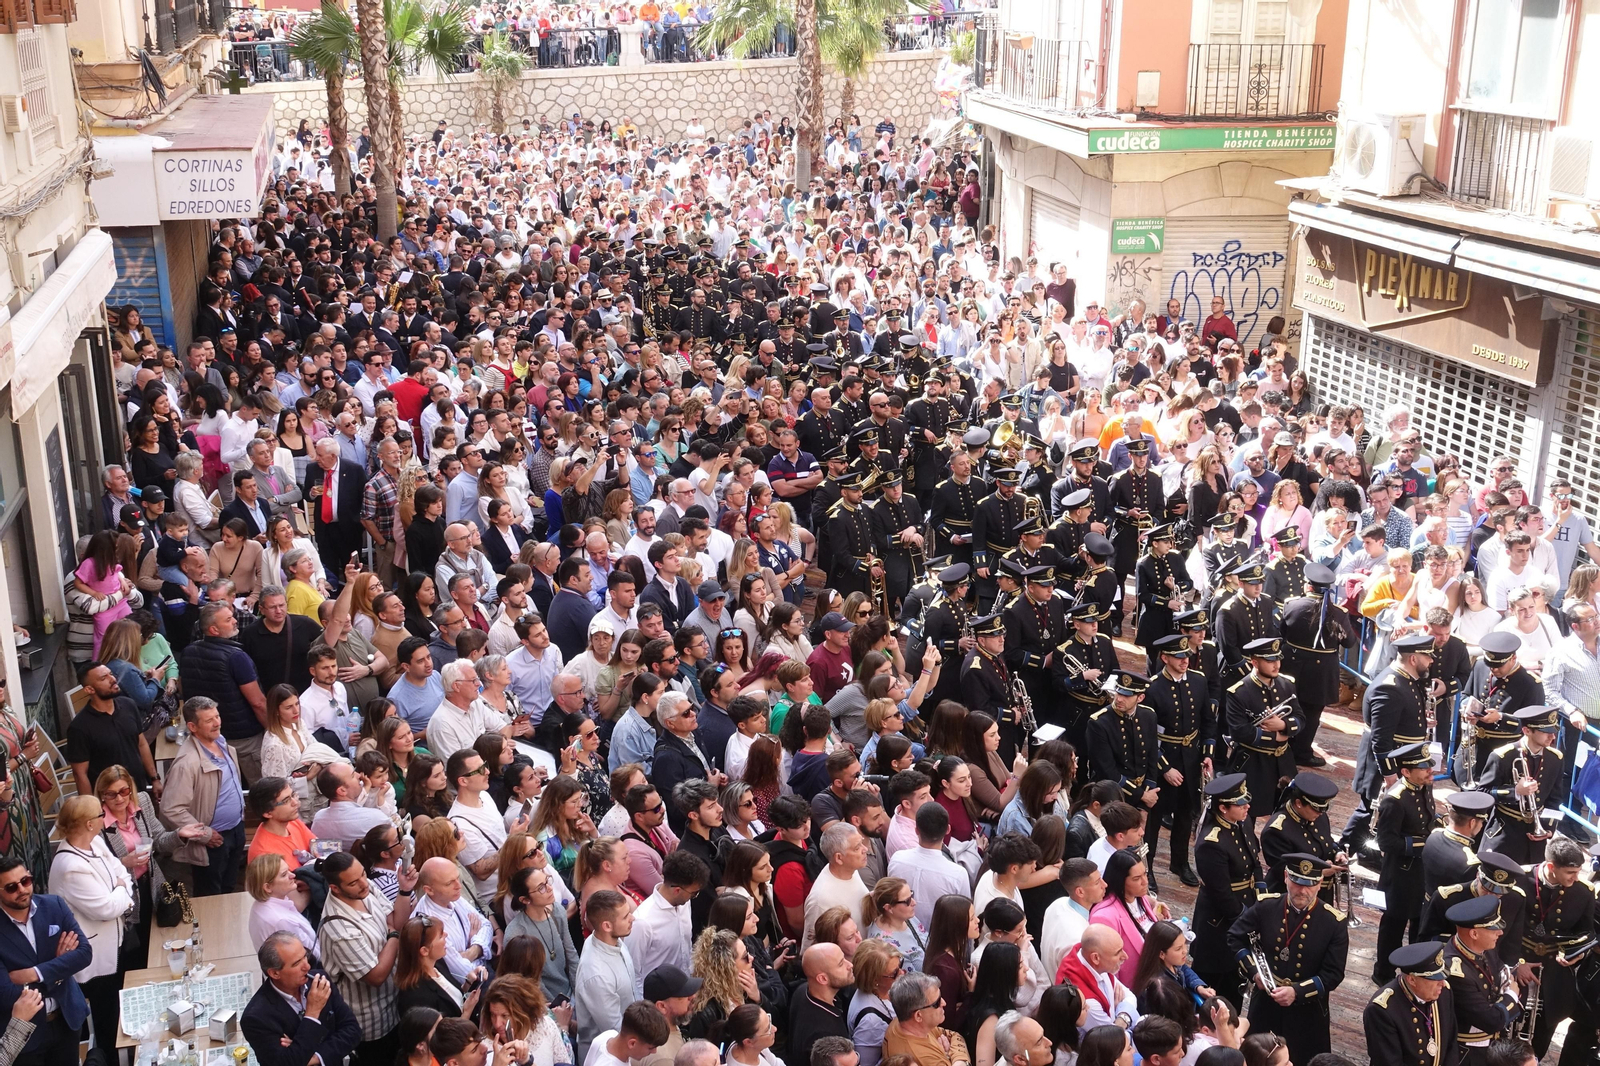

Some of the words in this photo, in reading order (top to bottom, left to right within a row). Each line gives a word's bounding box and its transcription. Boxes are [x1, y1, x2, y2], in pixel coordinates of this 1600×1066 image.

[1224, 129, 1268, 139] TIENDA
[1276, 127, 1333, 137] BENÉFICA
[1096, 131, 1160, 151] cudeca
[1223, 139, 1262, 148] HOSPICE
[1266, 138, 1305, 147] CHARITY
[1308, 137, 1333, 146] SHOP
[164, 158, 243, 173] CORTINAS
[189, 178, 235, 192] SILLOS
[169, 199, 251, 214] EDREDONES
[1117, 236, 1145, 245] cudeca
[1306, 256, 1336, 272] BOLSAS
[1305, 274, 1335, 290] FLORES
[1363, 248, 1459, 309] PLEXIMAR
[1303, 291, 1346, 312] PLASTICOS
[1471, 343, 1506, 364] DESDE
